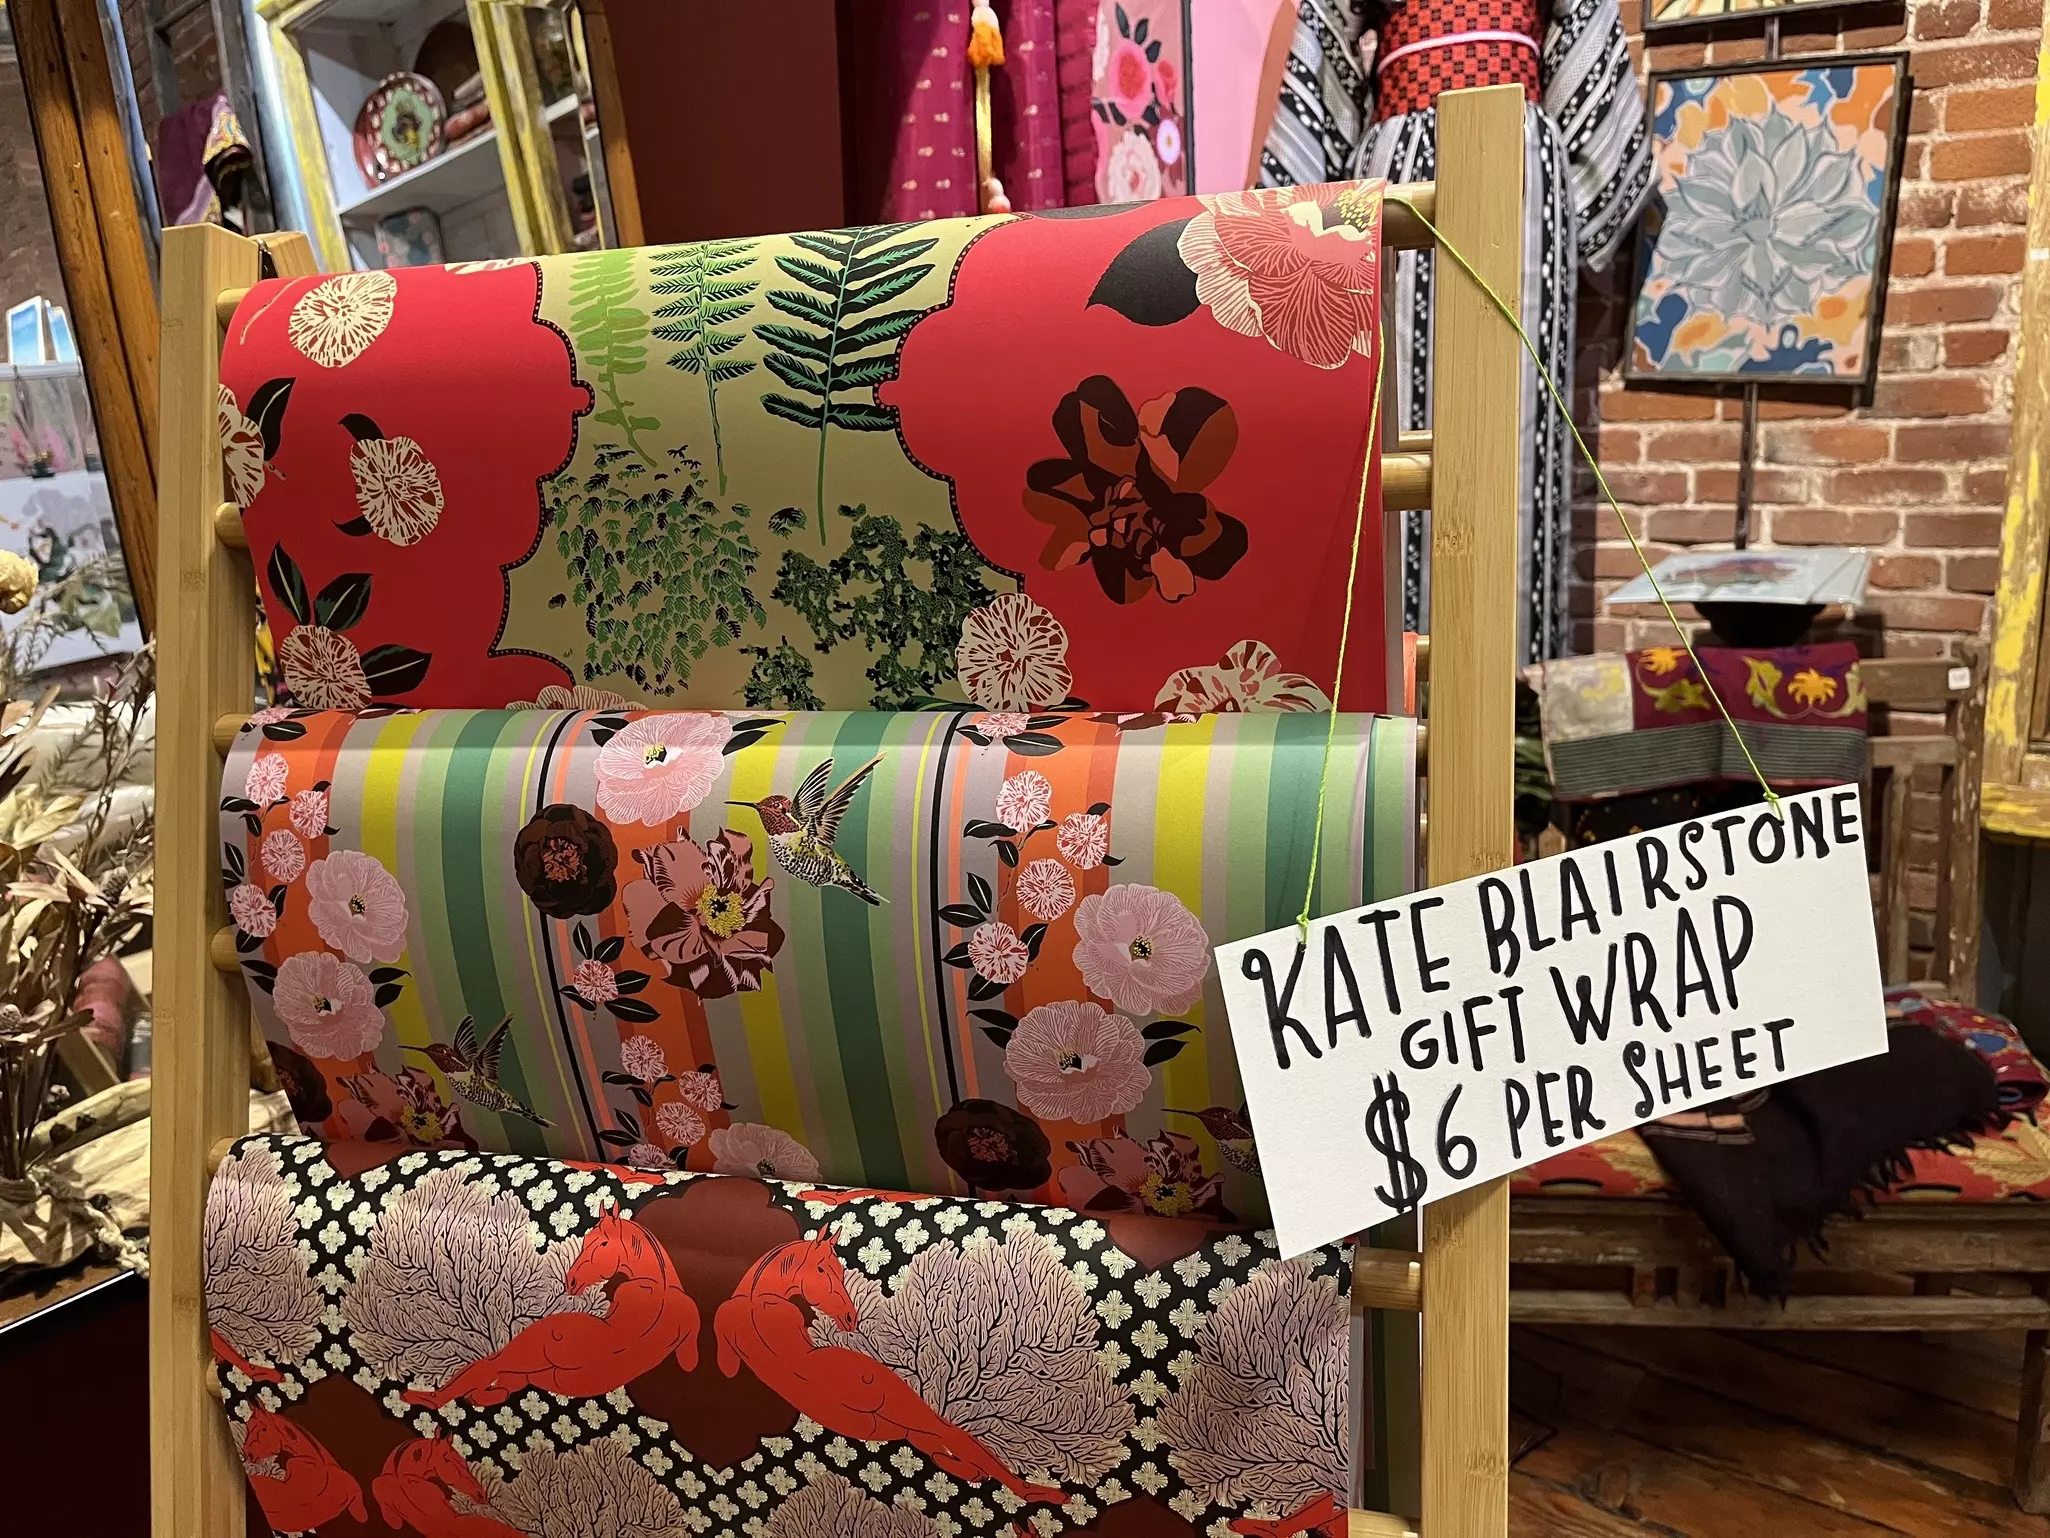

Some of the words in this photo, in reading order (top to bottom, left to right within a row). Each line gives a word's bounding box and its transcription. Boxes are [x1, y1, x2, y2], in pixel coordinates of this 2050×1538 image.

[1241, 896, 1450, 1070] KATE
[1477, 791, 1860, 979] BLAIRSTONE
[1400, 985, 1526, 1072] GIFT
[1548, 895, 1754, 1045] WRAP
[1364, 1069, 1478, 1213] $6
[1505, 1065, 1606, 1160] PER
[1621, 1018, 1795, 1119] SHEET
